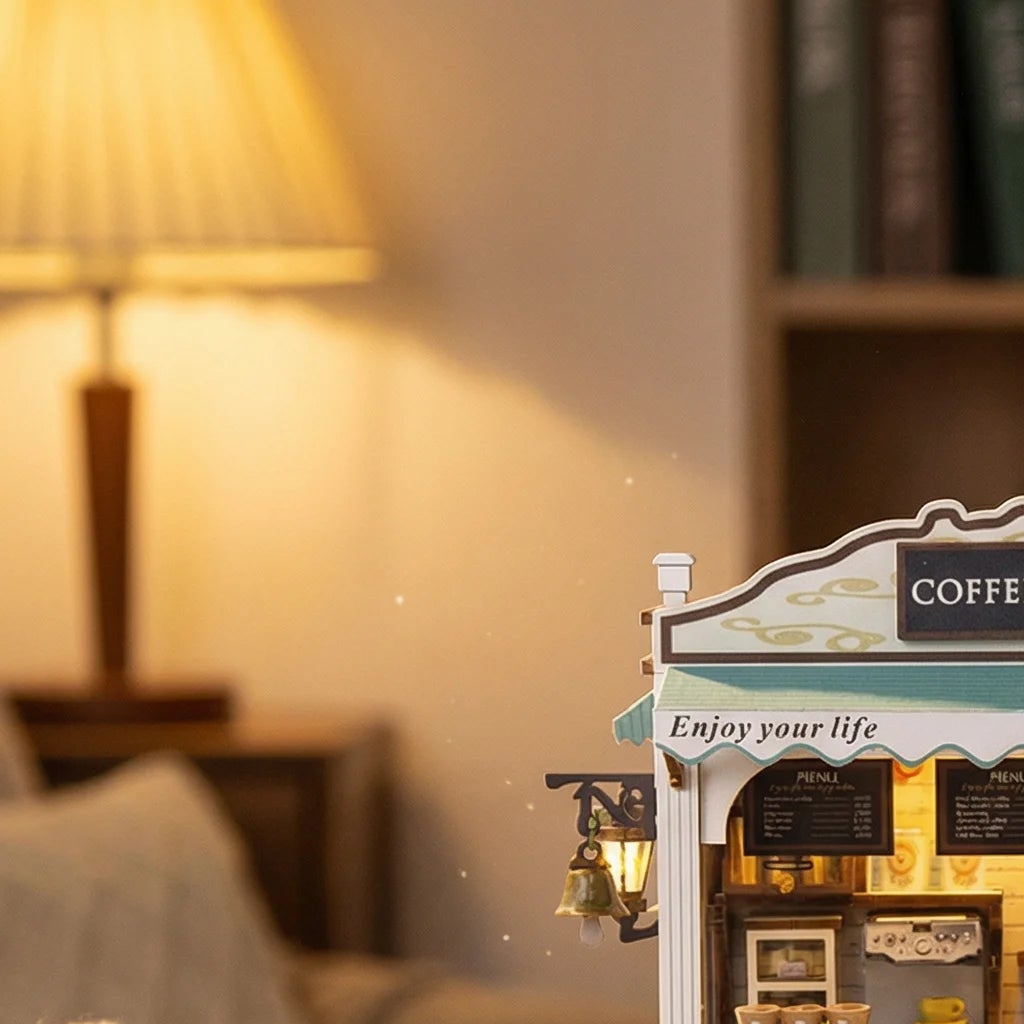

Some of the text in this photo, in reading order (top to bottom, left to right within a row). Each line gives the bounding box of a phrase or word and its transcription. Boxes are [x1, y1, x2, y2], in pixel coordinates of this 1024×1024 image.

[669, 715, 878, 745] Enjoy your life
